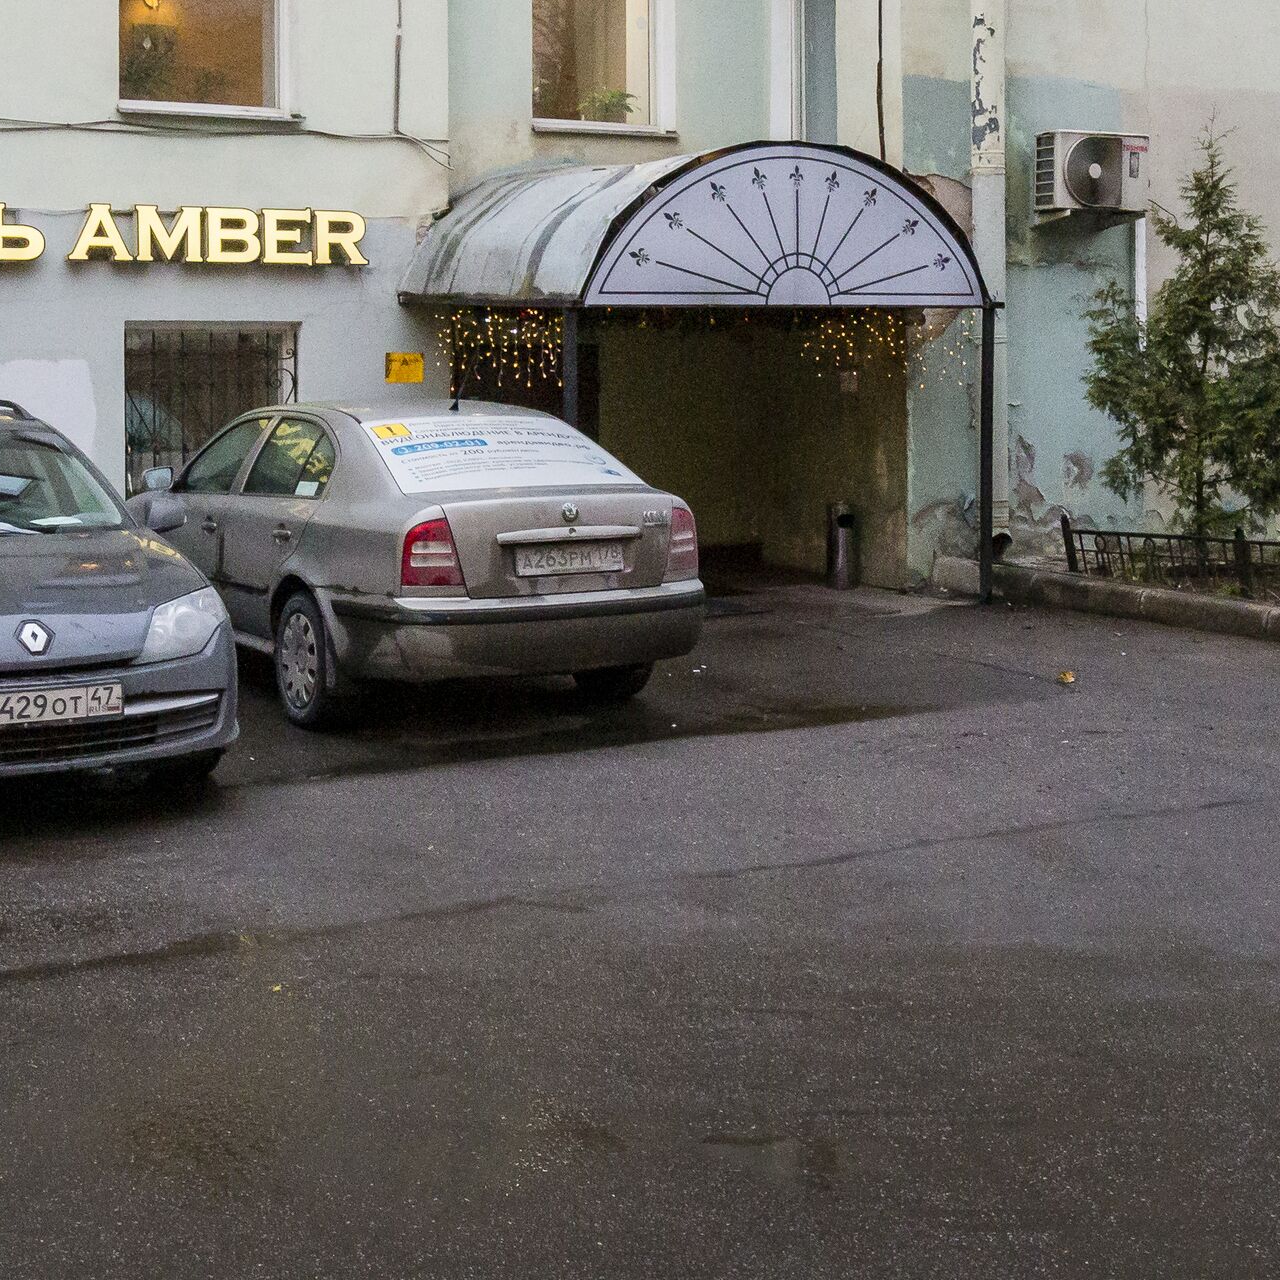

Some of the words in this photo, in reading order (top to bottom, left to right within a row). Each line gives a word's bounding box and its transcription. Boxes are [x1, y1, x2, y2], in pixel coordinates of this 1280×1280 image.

[68, 203, 369, 266] AMBER
[90, 686, 114, 706] 47
[89, 704, 108, 714] RUS
